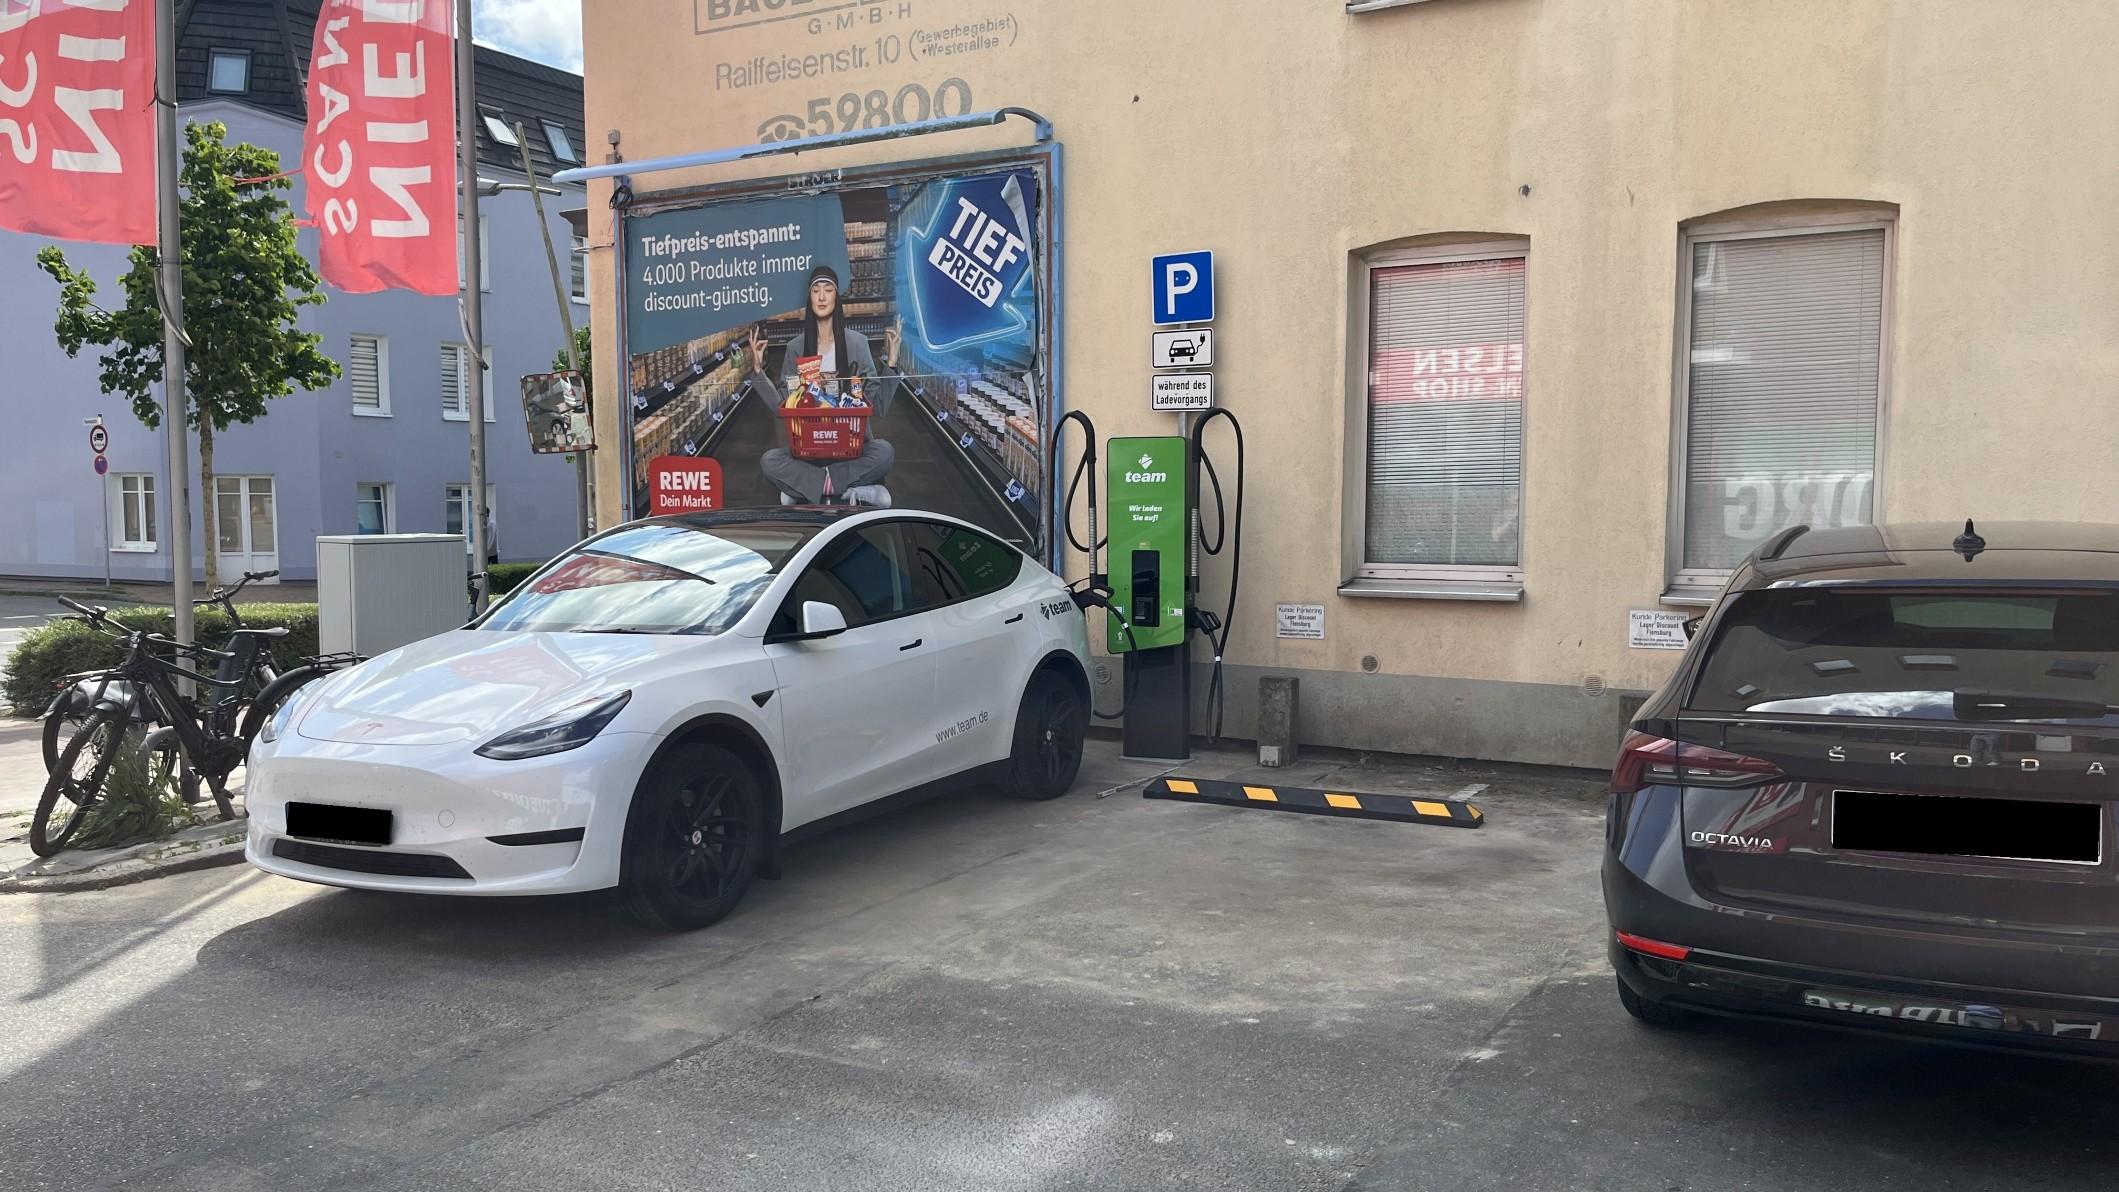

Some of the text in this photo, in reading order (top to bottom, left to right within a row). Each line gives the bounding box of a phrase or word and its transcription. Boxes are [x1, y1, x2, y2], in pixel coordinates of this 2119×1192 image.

[716, 35, 900, 90] Raiffeisenstr. 10
[807, 77, 973, 137] 59800
[642, 223, 801, 258] Tiefpreis-entspannt:
[949, 196, 1026, 273] TIEF
[643, 254, 812, 285] 4.000 Produkte immer
[937, 244, 995, 300] PREIS
[644, 282, 773, 312] discount-günstig.
[1166, 262, 1198, 315] P
[1156, 394, 1208, 406] Ladevorgangs
[1157, 379, 1206, 391] während des
[813, 430, 838, 439] REWE
[660, 471, 711, 491] REWE
[1125, 470, 1167, 483] team
[660, 494, 711, 508] Dein Markt
[1049, 600, 1072, 616] team
[935, 709, 988, 743] www.team.de
[1690, 830, 1774, 851] OCTAVIA
